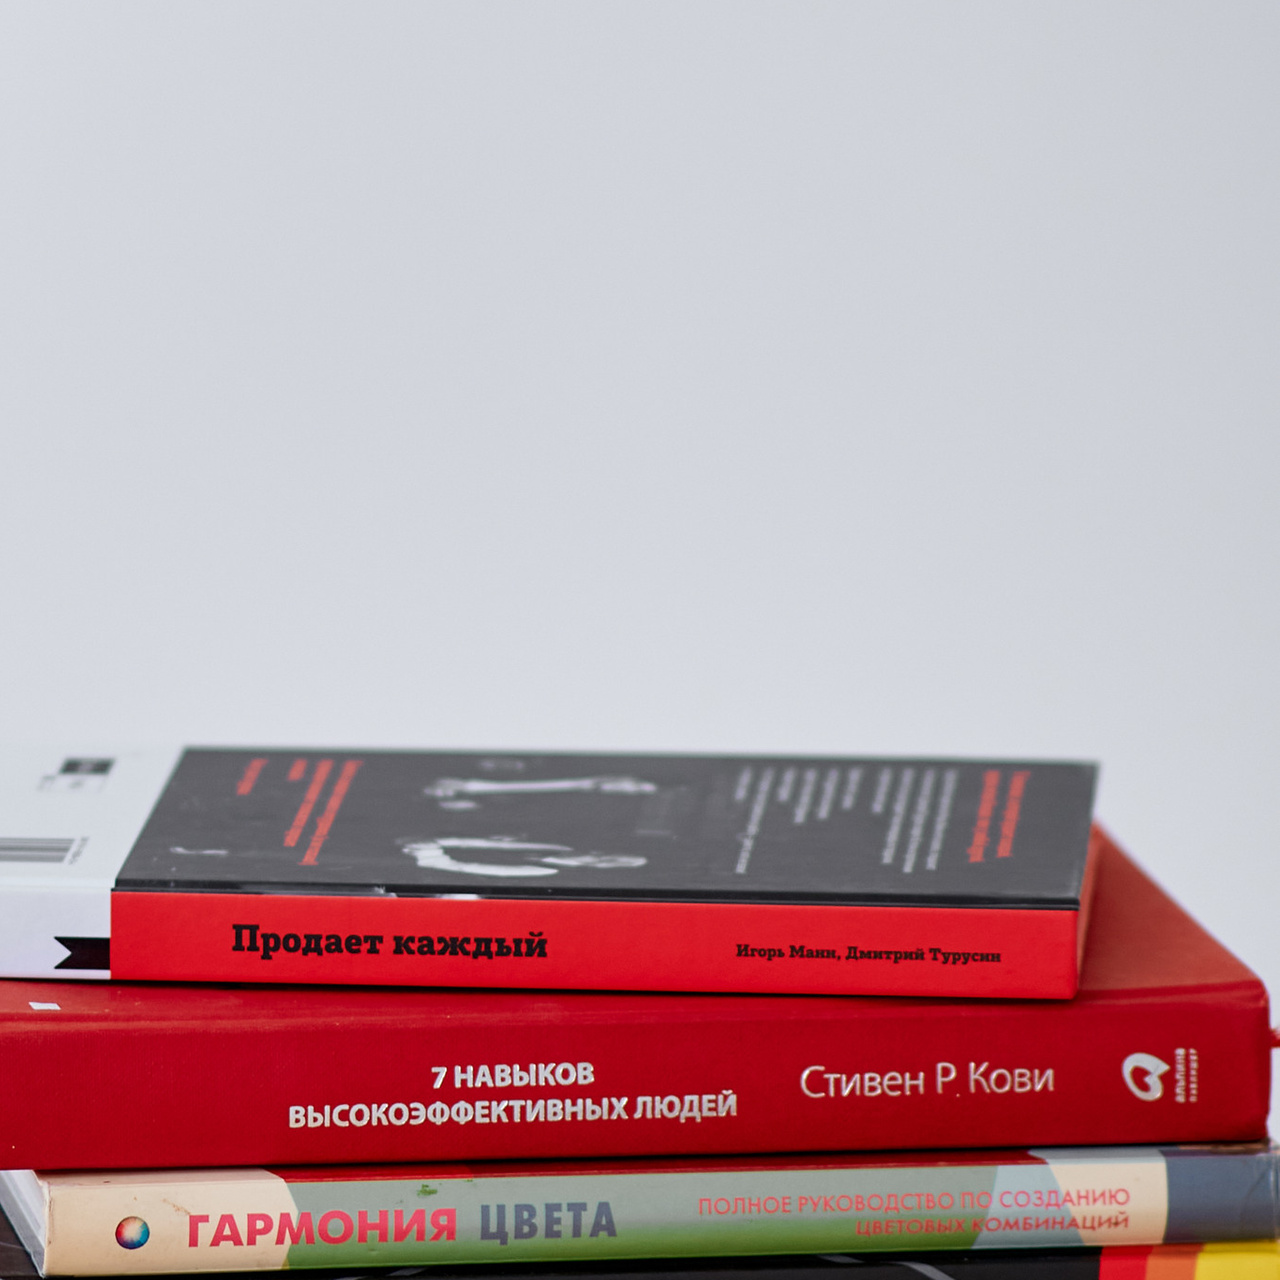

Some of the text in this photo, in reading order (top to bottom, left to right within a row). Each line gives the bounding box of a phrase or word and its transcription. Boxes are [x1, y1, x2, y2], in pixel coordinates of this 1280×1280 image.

[231, 923, 549, 960] Продает каждый
[736, 943, 1002, 965] Игорь Манн, Дмитрий Турусин
[431, 1061, 595, 1090] 7 НАВЫКОВ
[799, 1060, 1055, 1099] Стивен Р. Кови
[288, 1088, 739, 1129] ВЫСОКОЭФФЕКТИВНЫХ ЛЮДЕЙ
[698, 1187, 1131, 1216] ПОЛНОЕ РУКОВОДСТВО ПО СОЗДАНИЮ
[187, 1200, 618, 1248] ГАРМОНИЯ ЦВЕТА
[855, 1210, 1130, 1238] ЦВЕТОВЫХ КОМБИНАЦИЙ
